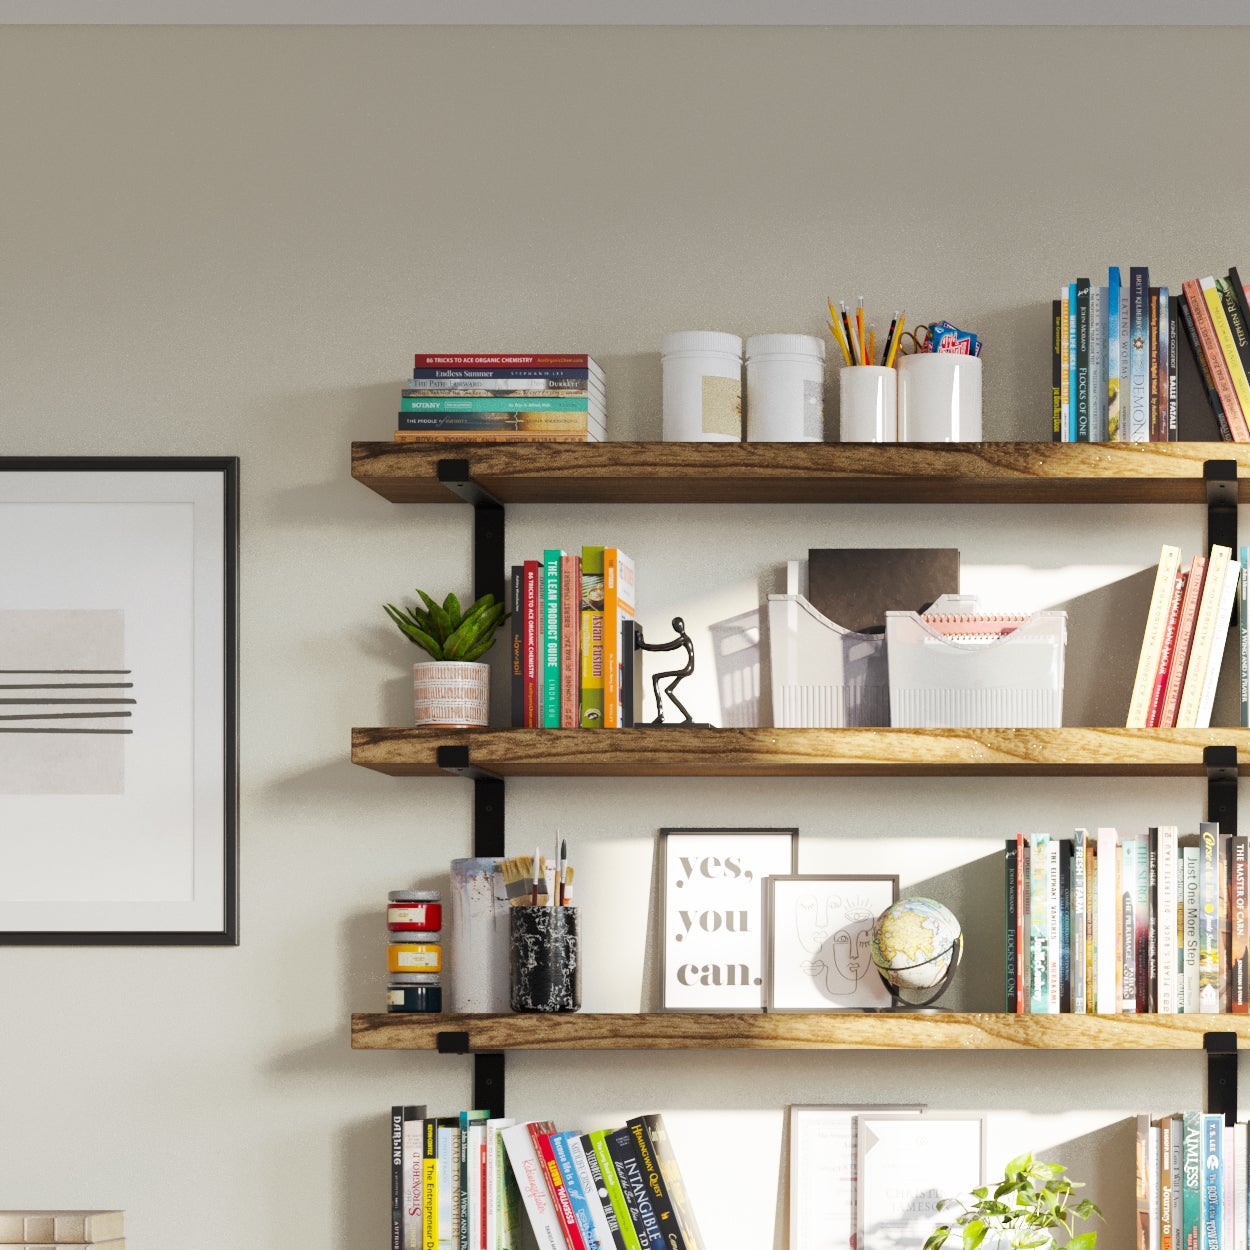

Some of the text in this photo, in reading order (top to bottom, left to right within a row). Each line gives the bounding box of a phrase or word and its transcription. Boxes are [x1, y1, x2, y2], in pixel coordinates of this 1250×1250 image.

[1079, 368, 1087, 436] FLOCKS OF ONE
[548, 561, 557, 667] THE LEAN PRODUCT GUIDE
[591, 615, 604, 677] Asian Fusion
[676, 856, 753, 889] yes,
[1236, 844, 1244, 862] THE
[1236, 864, 1244, 896] MASTER
[675, 910, 749, 942] you
[1186, 857, 1197, 966] Just One More Step
[677, 963, 762, 986] can.
[393, 1116, 401, 1165] DARLING
[631, 1124, 663, 1198] HEMINGWAY QUEST
[1184, 1128, 1199, 1189] AIMLESS
[426, 1165, 434, 1181] The
[426, 1183, 434, 1239] Entrepreneur
[624, 1157, 662, 1242] INTANGIBLE
[1162, 1186, 1172, 1223] Journey
[1164, 1225, 1171, 1234] to
